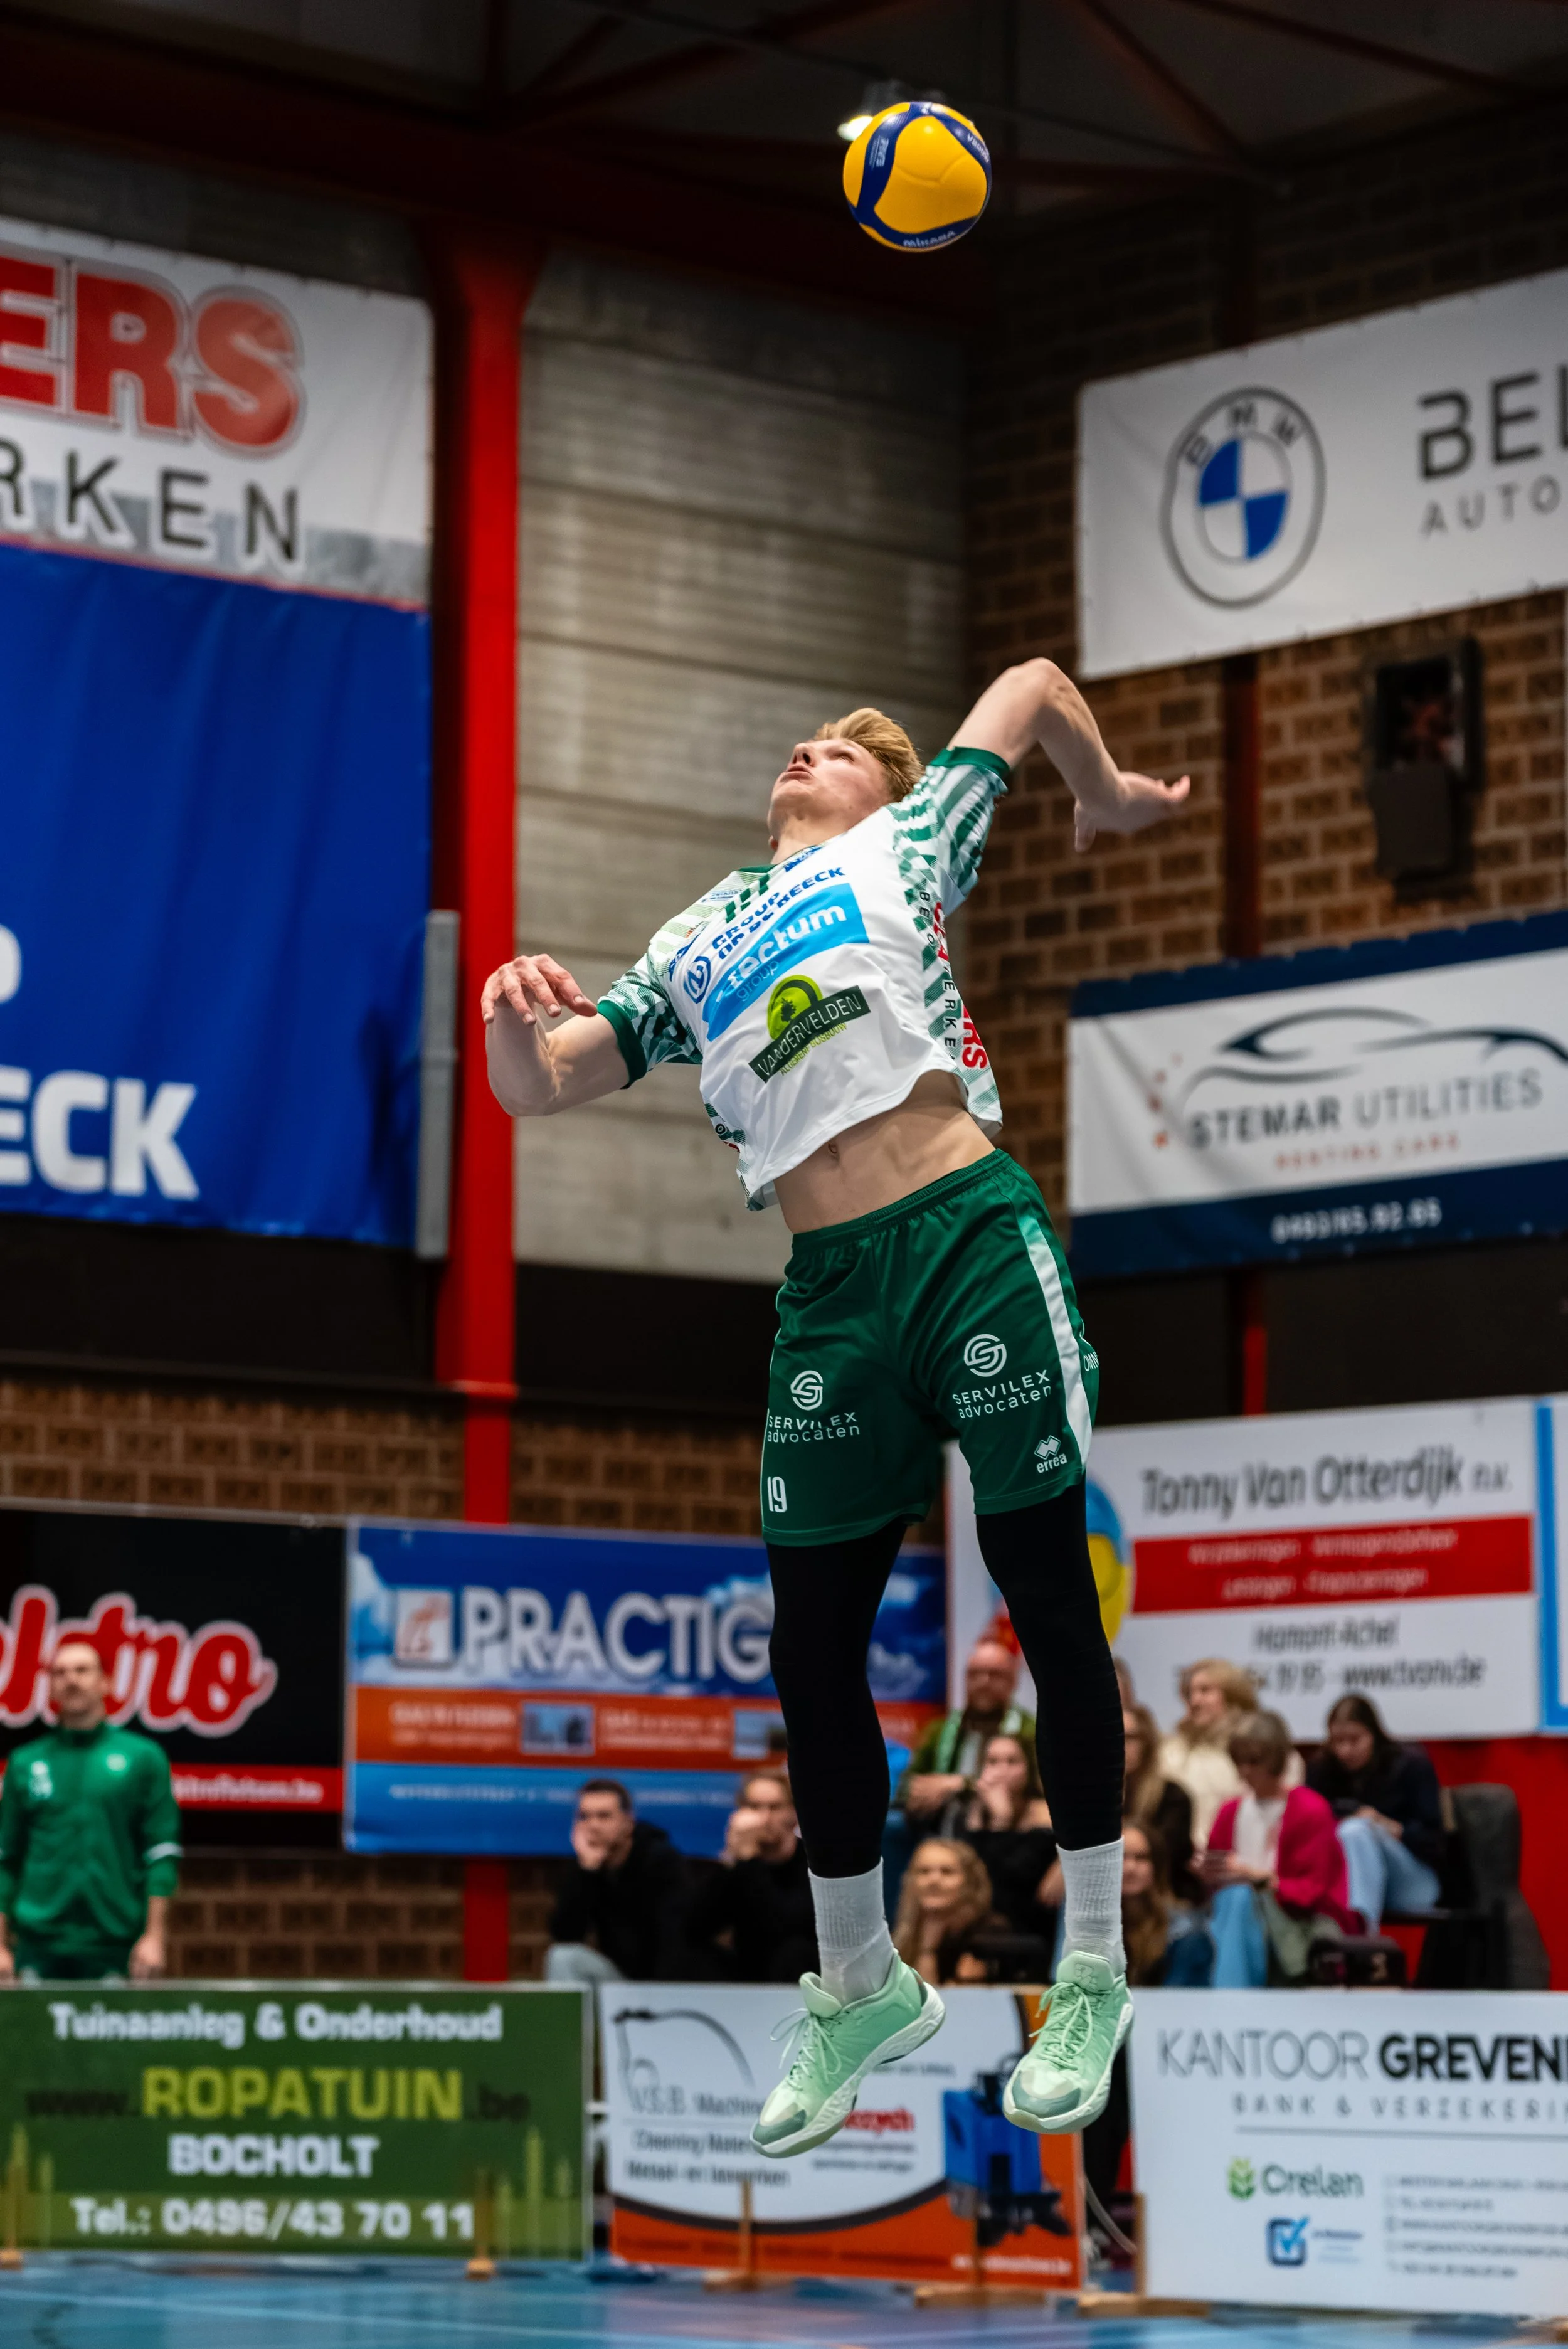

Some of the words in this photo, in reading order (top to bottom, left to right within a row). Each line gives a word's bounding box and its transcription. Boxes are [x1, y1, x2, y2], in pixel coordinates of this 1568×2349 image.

[1419, 474, 1562, 536] AUTO
[712, 892, 780, 949] GROUP
[736, 959, 781, 1002] group
[757, 993, 862, 1076] VANDERVELDEN
[1189, 1095, 1342, 1151] STEMAR
[1352, 1067, 1544, 1128] UTILITIES
[952, 1369, 1051, 1405] SERVILEX
[959, 1384, 1052, 1419] advocaten
[767, 1425, 860, 1444] advocaten
[768, 1411, 857, 1431] SERVILEX
[767, 1476, 788, 1513] 19
[1140, 1466, 1240, 1522] Tonny
[1242, 1460, 1306, 1507] Van
[1315, 1445, 1464, 1507] Otterdijk
[253, 2004, 286, 2042] &
[295, 2003, 504, 2042] Onderhoud
[1157, 2028, 1370, 2081] KANTOOR
[1379, 2032, 1568, 2084] GREVEN
[1232, 2092, 1316, 2116] BANK
[1370, 2096, 1568, 2123] VERZEKERI
[168, 2134, 381, 2177] BOCHOLT
[1260, 2163, 1365, 2198] Crelan
[353, 2202, 411, 2239] 70
[421, 2202, 475, 2239] 11
